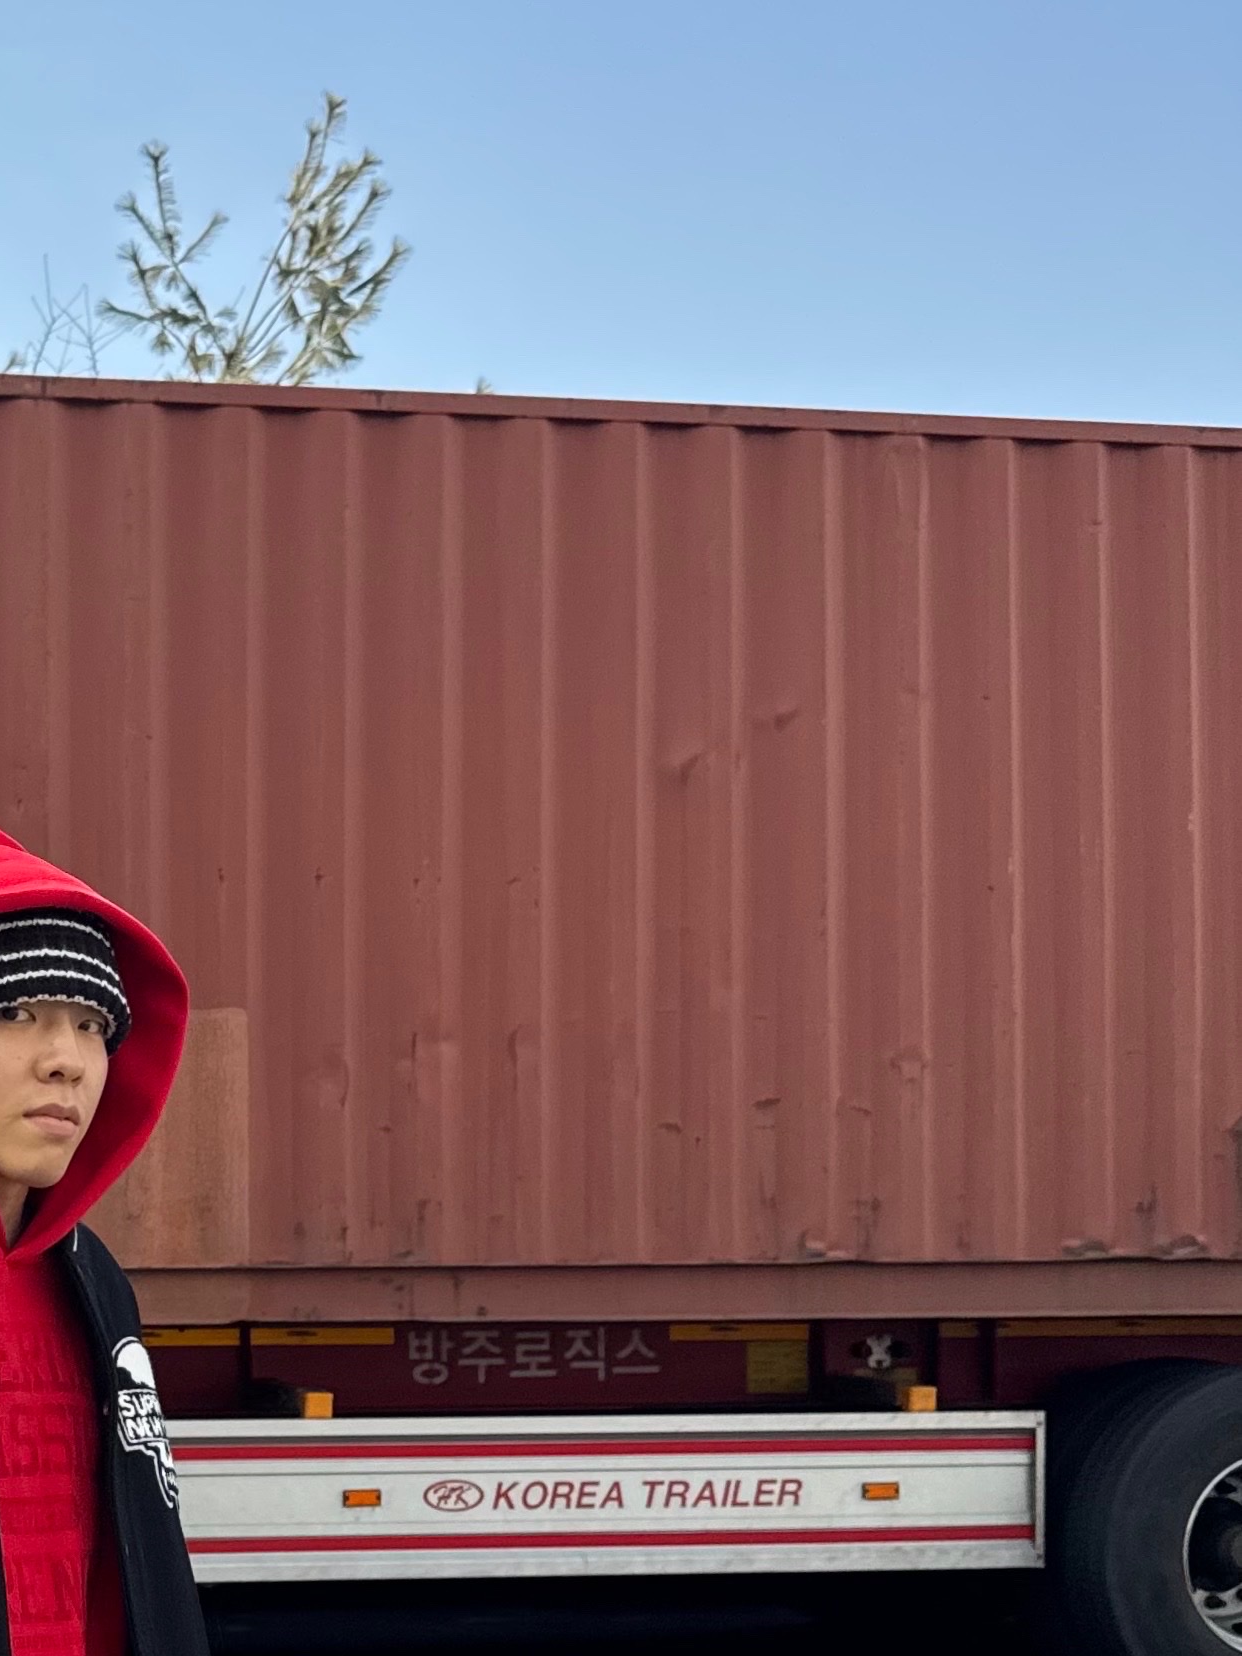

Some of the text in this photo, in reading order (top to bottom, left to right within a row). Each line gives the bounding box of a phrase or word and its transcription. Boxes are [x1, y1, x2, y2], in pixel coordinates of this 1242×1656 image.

[408, 1326, 661, 1385] 방주로직스
[492, 1480, 624, 1510] KOREA
[643, 1478, 802, 1509] TRAILER
